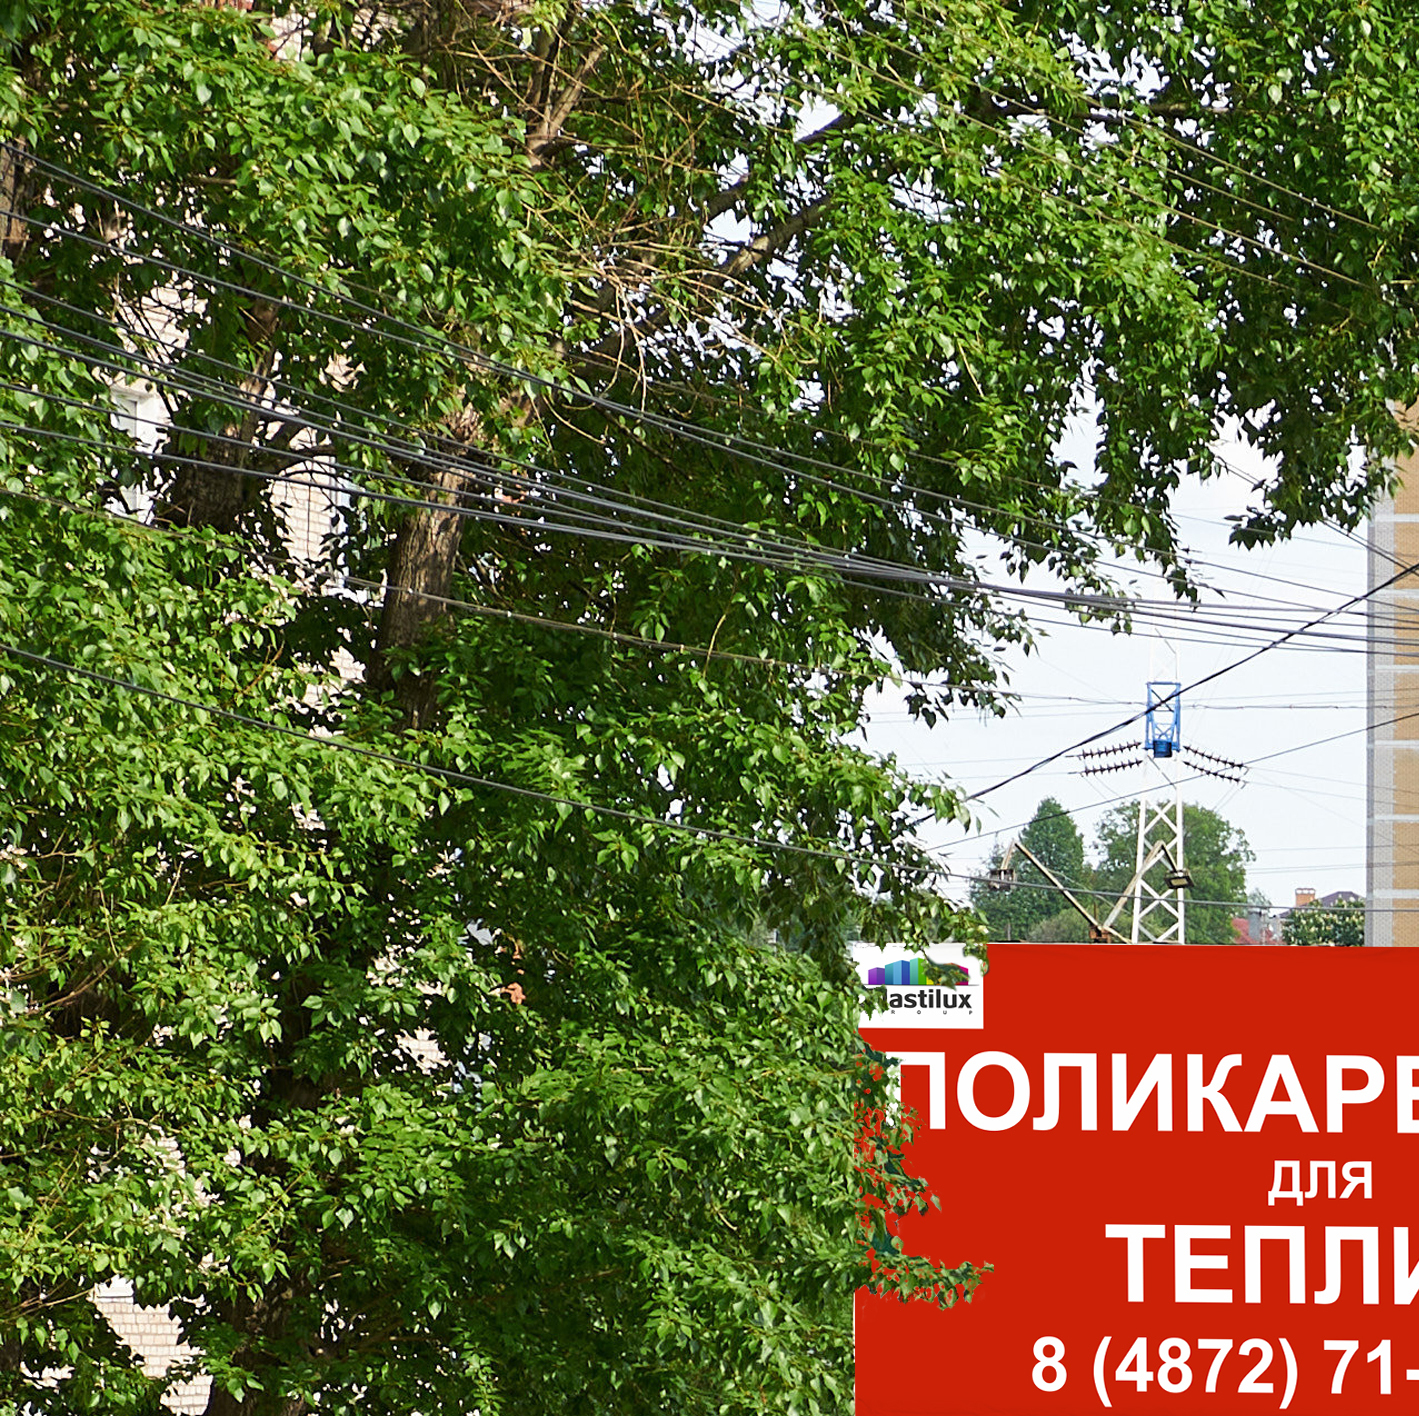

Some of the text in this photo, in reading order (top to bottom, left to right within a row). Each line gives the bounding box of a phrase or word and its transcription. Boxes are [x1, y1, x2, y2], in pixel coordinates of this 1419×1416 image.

[1267, 1160, 1373, 1207] для
[1031, 1336, 1067, 1392] 8
[1093, 1336, 1298, 1410] (4872)
